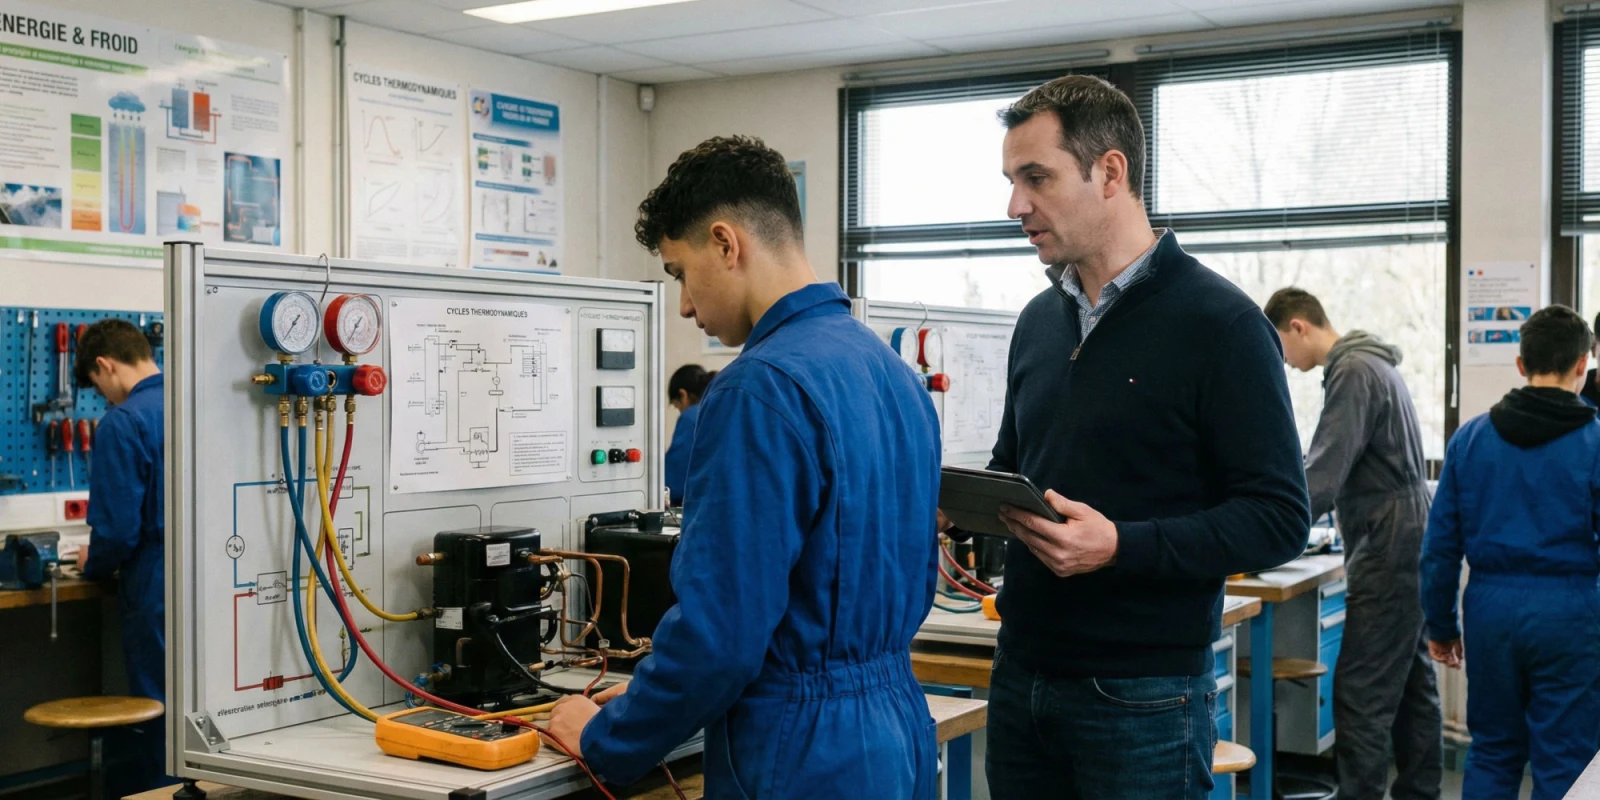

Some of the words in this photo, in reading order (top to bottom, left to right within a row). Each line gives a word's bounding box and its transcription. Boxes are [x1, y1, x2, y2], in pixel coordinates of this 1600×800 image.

[0, 12, 68, 43] NERGIE
[72, 26, 85, 46] &
[90, 30, 138, 55] FROID
[353, 71, 382, 87] CYCLES
[383, 76, 458, 100] THERMODYNAMIQUES
[446, 306, 470, 316] CYCLES
[470, 307, 528, 318] THERMODYNAMIQUES
